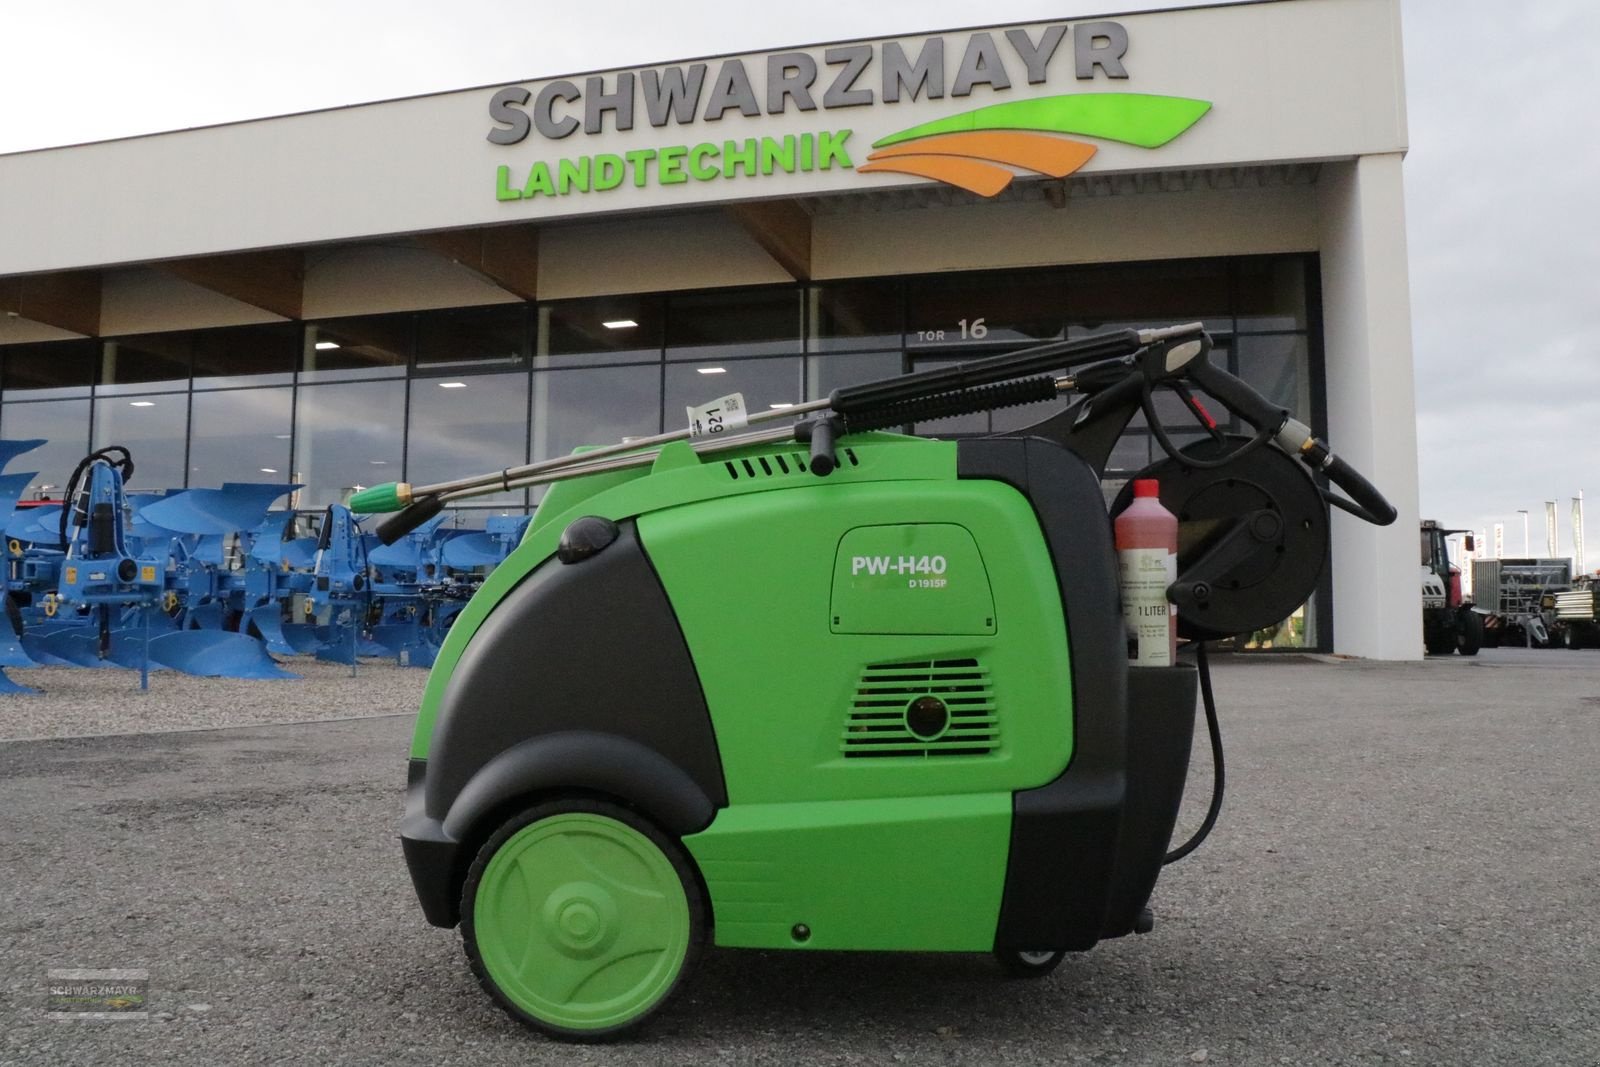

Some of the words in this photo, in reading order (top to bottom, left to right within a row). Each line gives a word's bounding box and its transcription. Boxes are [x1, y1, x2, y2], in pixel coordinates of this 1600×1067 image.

[486, 21, 1130, 146] SCHWARZMAYR
[495, 129, 857, 203] LANDTECHNIK
[917, 330, 945, 341] TOR
[958, 317, 988, 340] 16
[852, 555, 947, 576] PW-H40
[909, 579, 917, 588] D
[1144, 605, 1167, 616] LITER
